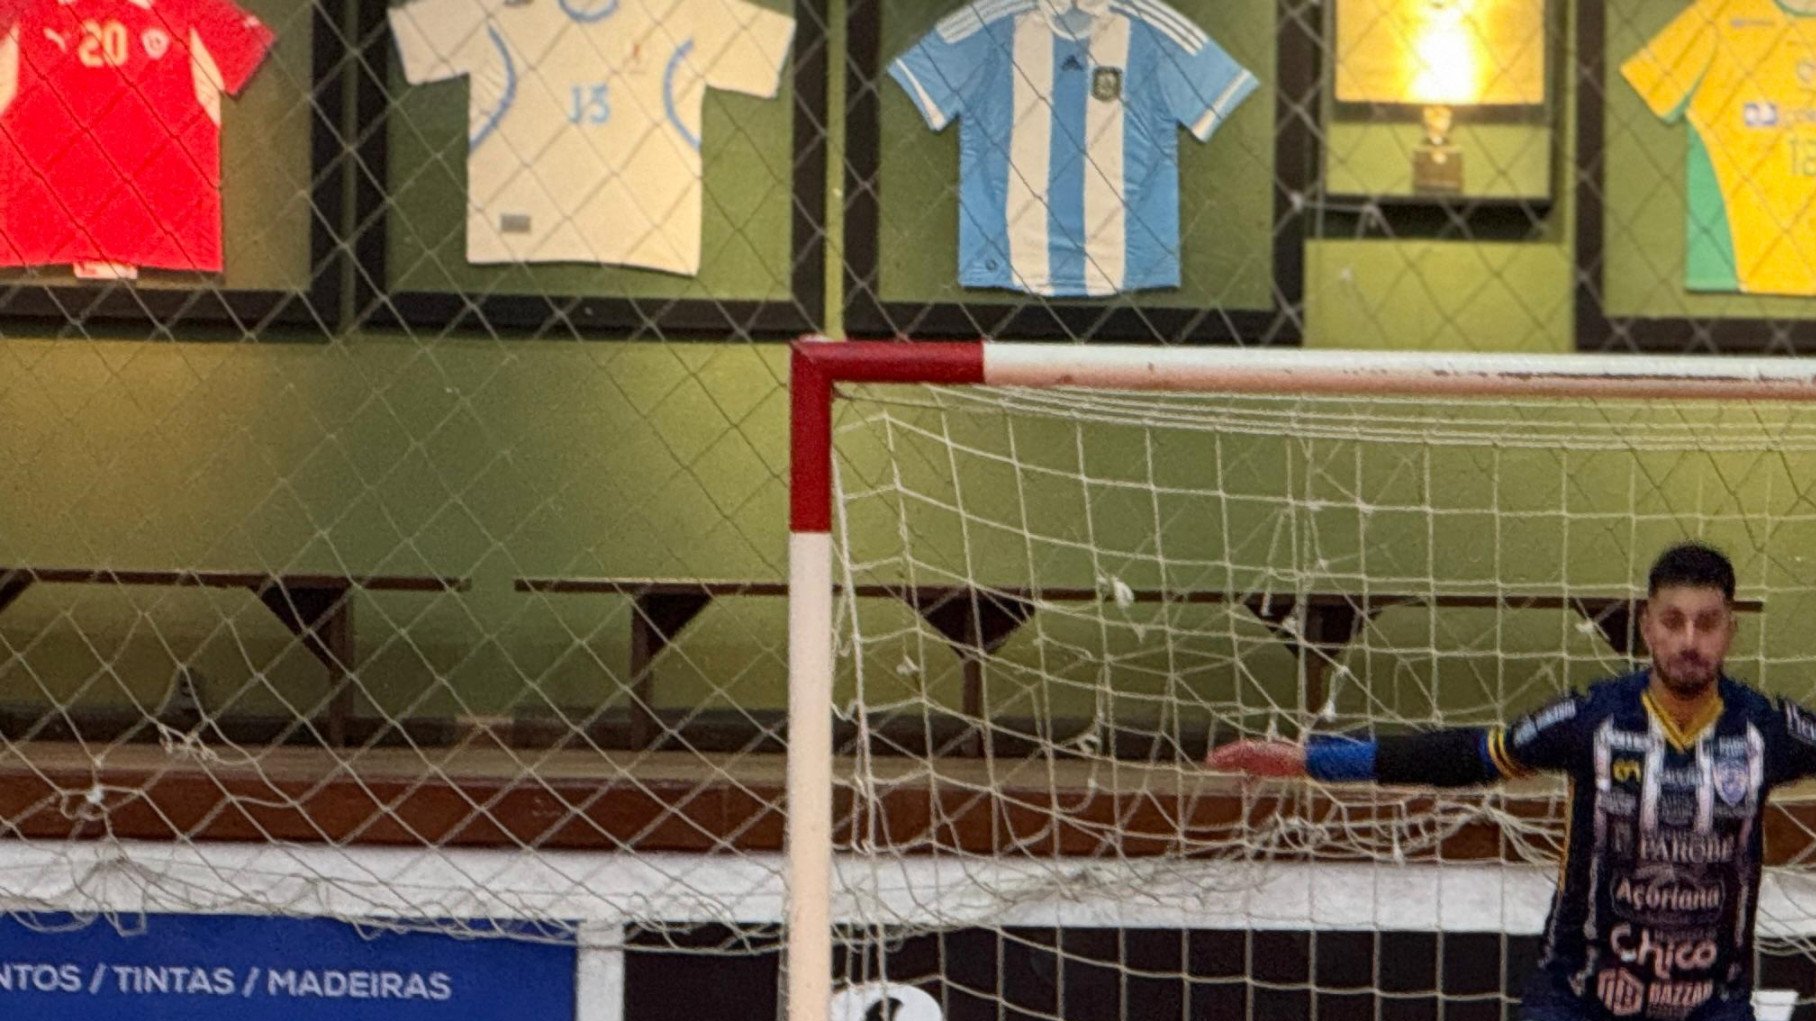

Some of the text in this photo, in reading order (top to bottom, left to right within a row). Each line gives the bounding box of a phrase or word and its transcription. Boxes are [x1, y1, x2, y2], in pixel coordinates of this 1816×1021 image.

[79, 19, 127, 67] 20
[1610, 922, 1717, 979] Chico
[112, 965, 235, 995] TINTAS
[267, 968, 452, 1000] MADEIRAS
